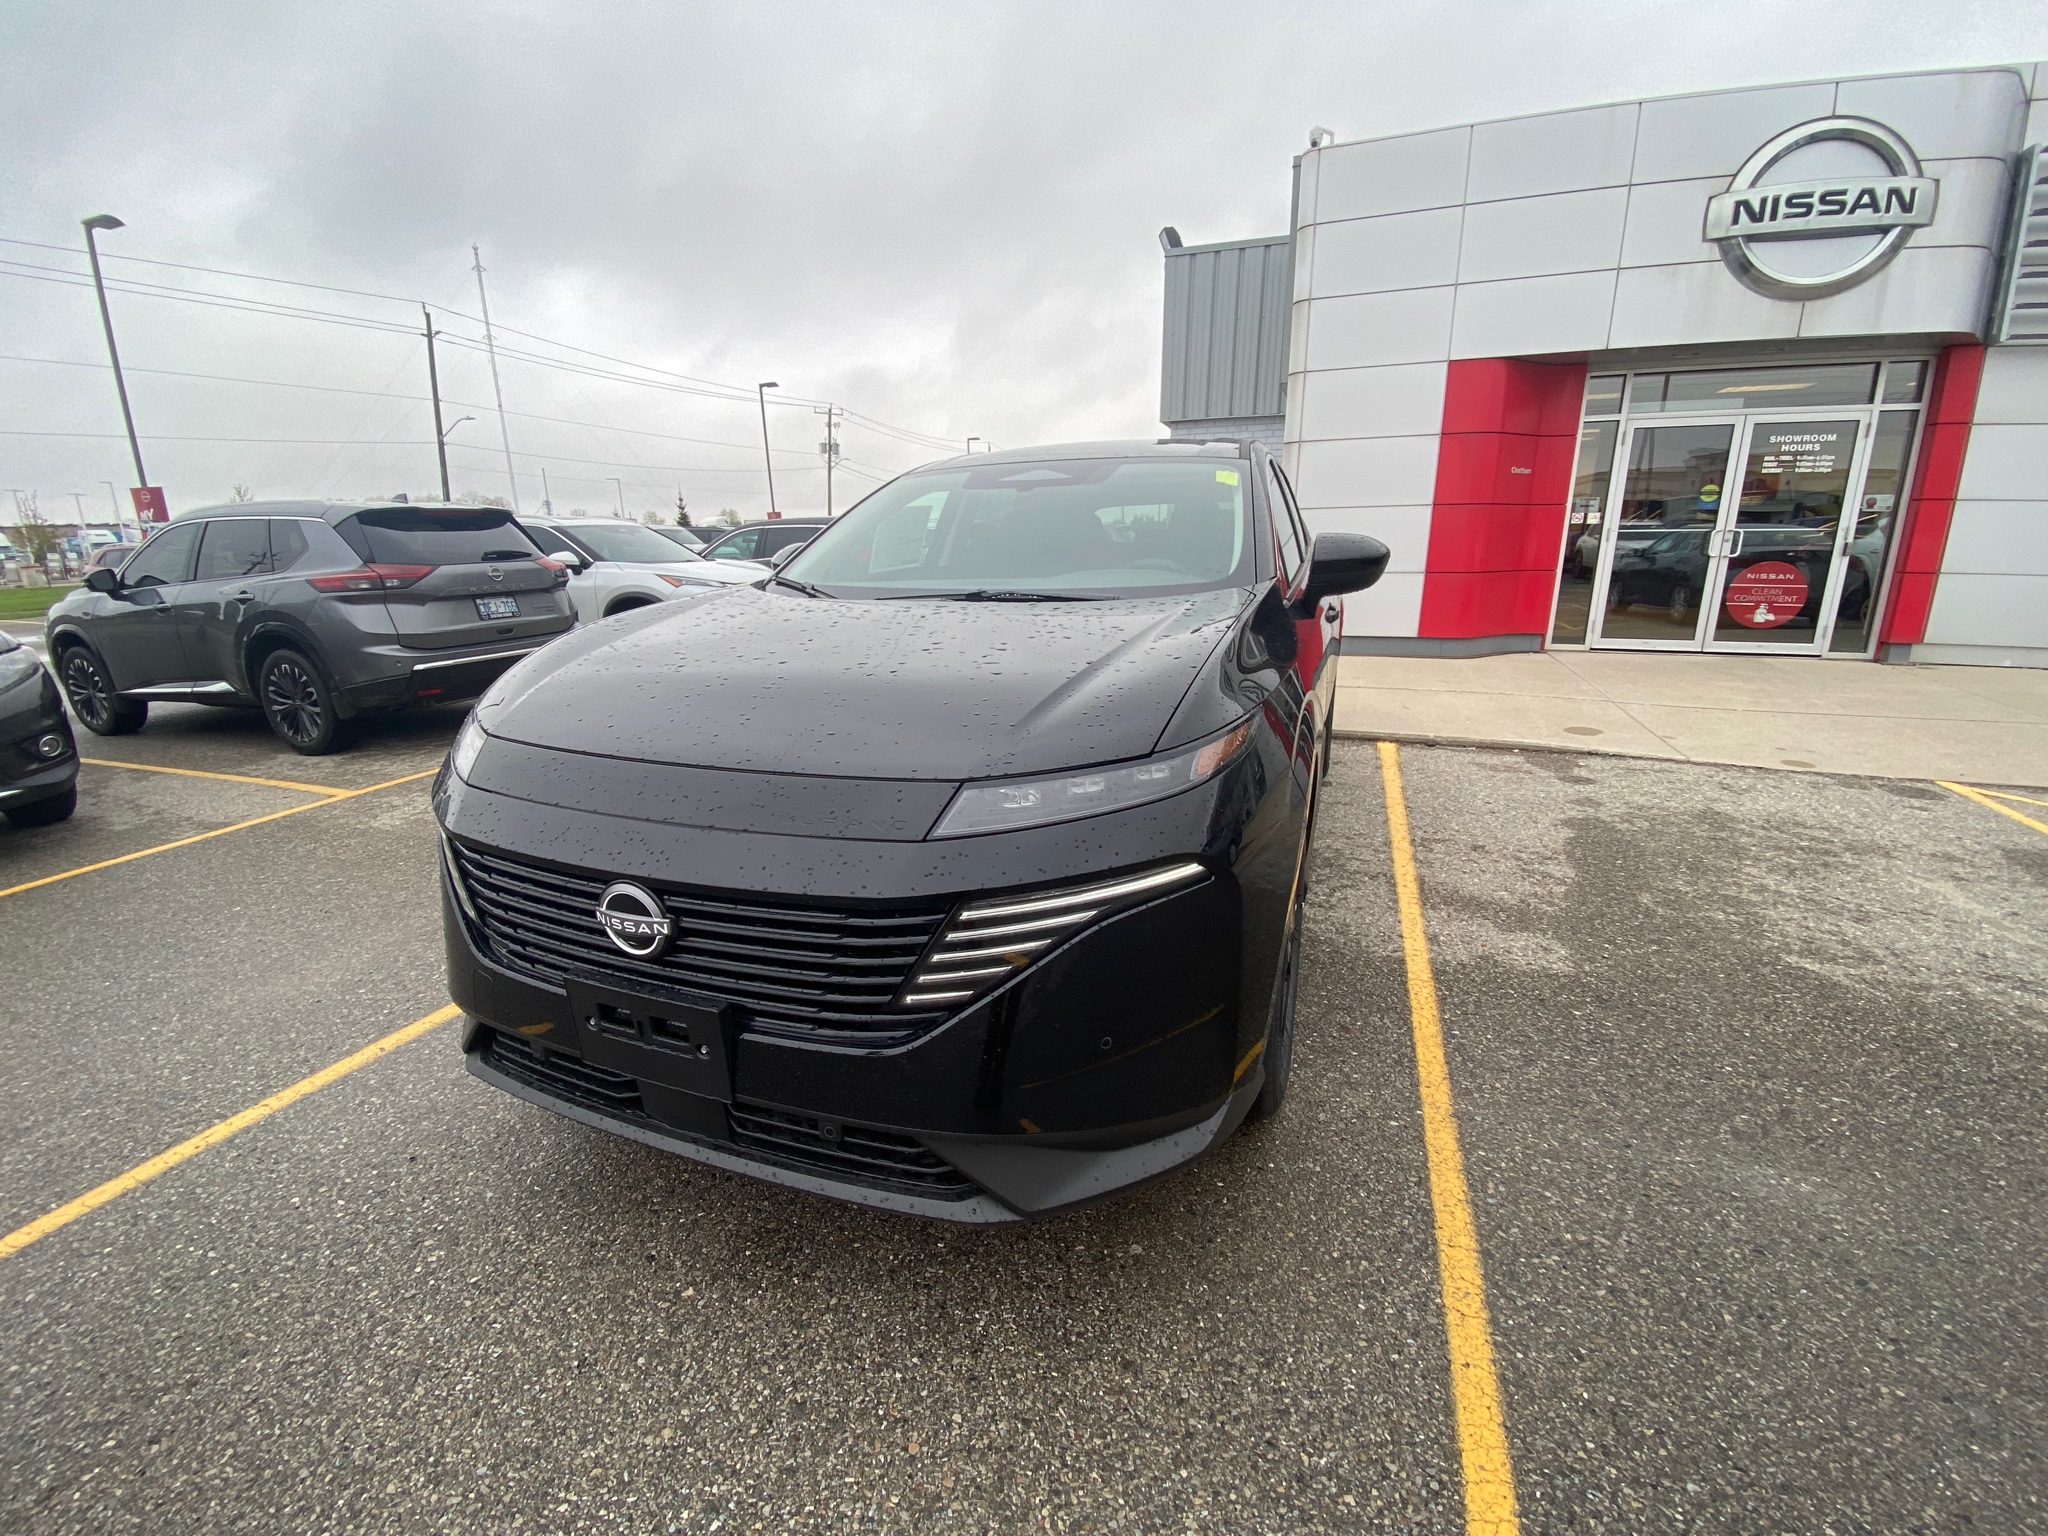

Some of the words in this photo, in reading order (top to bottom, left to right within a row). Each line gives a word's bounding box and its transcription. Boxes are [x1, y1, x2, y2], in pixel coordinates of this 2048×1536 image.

[1731, 187, 1918, 226] NISSAN
[1769, 434, 1837, 443] SHOWROOM
[1781, 443, 1821, 452] HOURS
[1734, 595, 1798, 603] COMMITMENT
[596, 910, 669, 934] NISSAN
